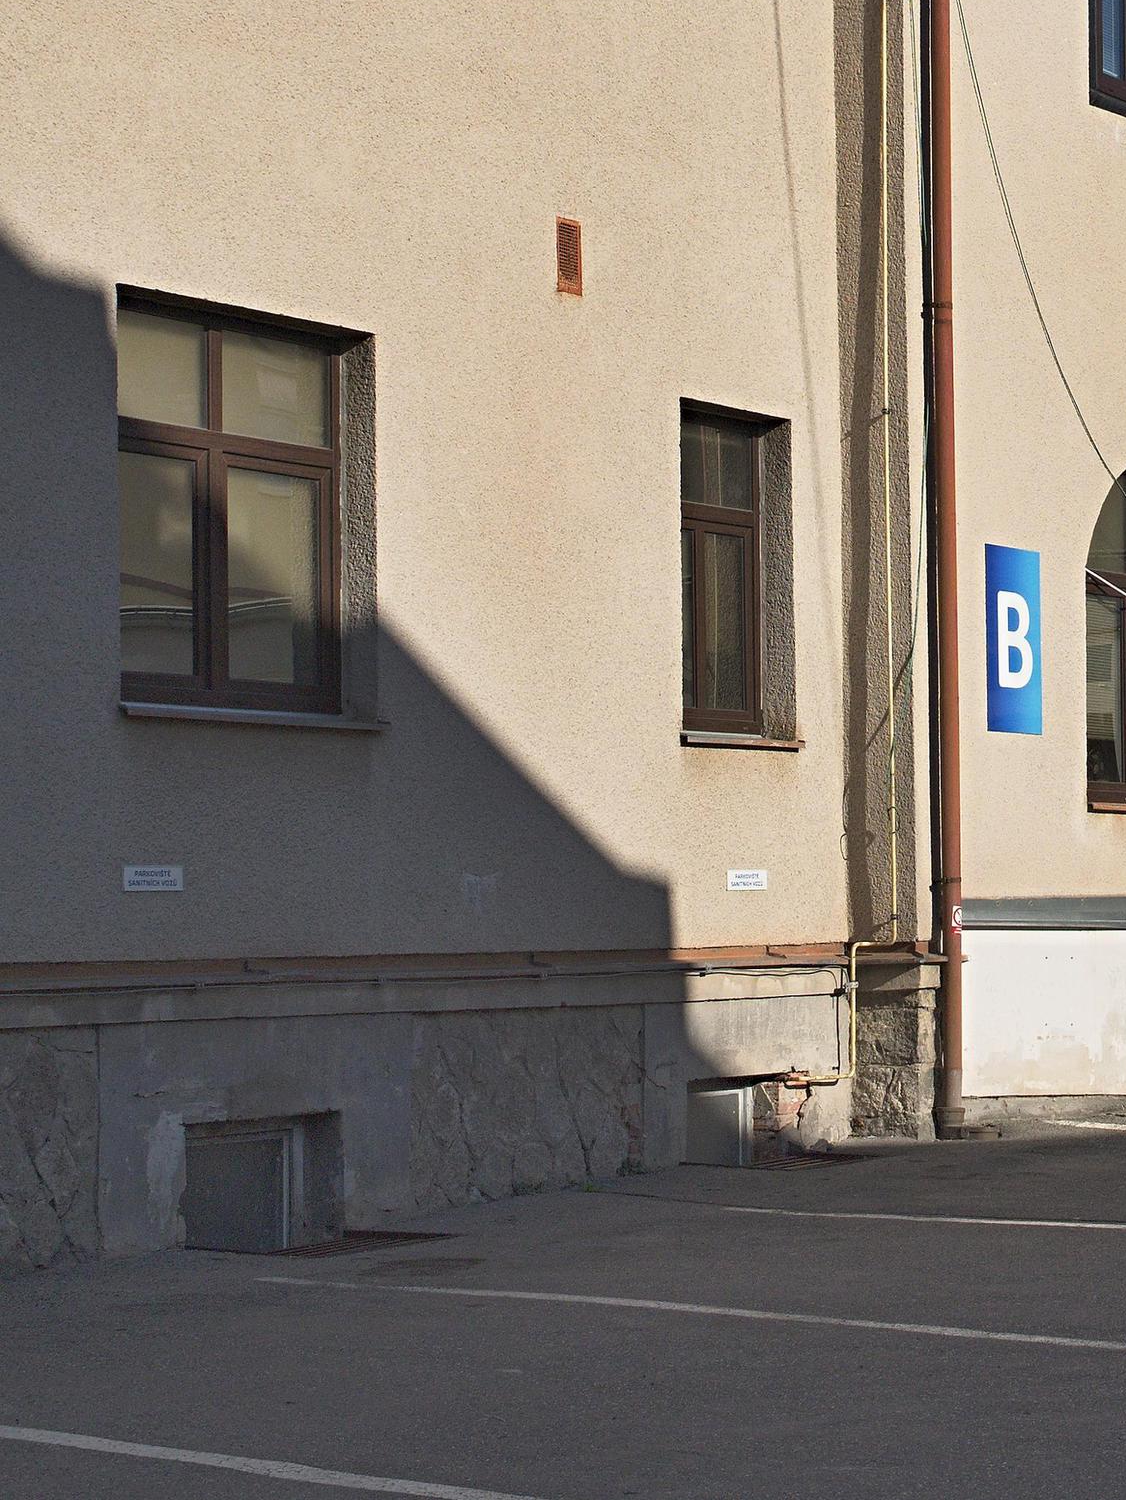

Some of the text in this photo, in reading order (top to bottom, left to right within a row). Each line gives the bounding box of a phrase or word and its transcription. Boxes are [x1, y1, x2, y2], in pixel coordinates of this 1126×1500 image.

[997, 590, 1033, 689] B
[134, 869, 171, 877] PARKOVIŠTĚ
[128, 879, 160, 887] SANITNÍCH
